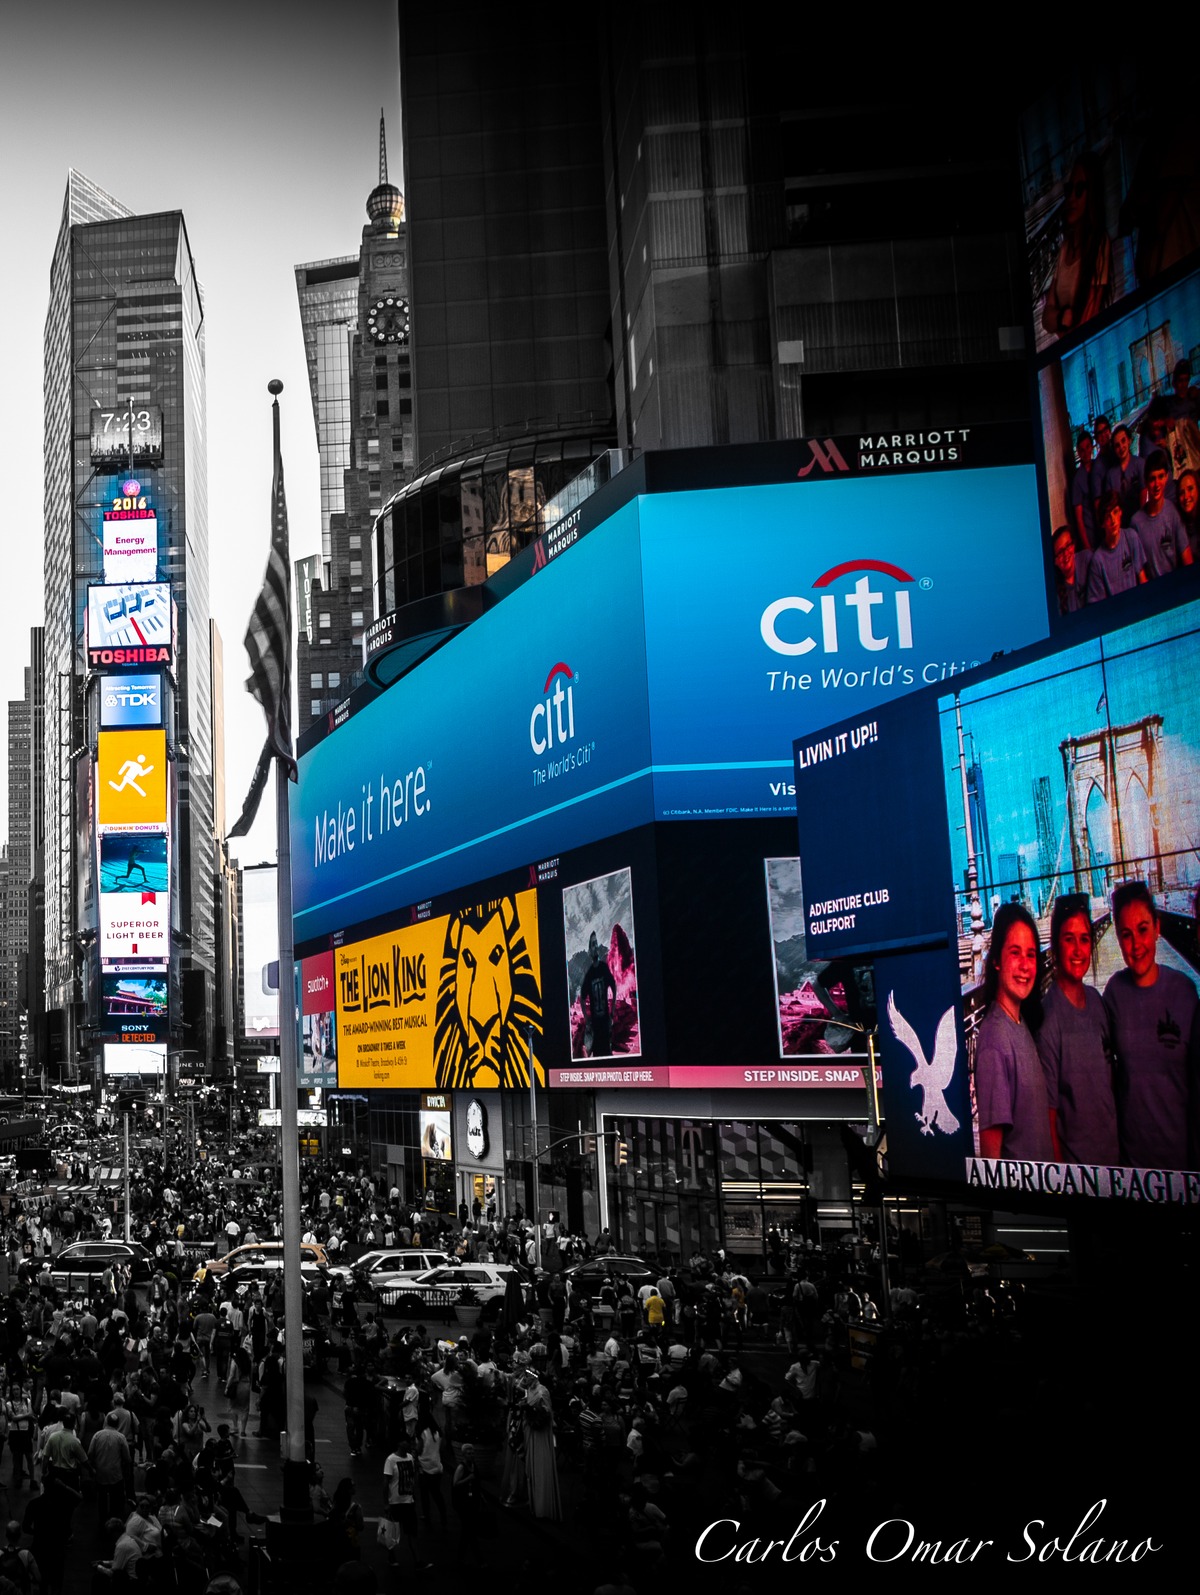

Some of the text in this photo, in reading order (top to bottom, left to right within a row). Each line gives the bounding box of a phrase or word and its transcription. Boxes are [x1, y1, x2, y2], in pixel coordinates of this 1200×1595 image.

[101, 411, 151, 433] 7:23
[859, 429, 970, 449] MARRIOTT
[860, 447, 960, 468] MARQUIS
[112, 497, 147, 511] 2016
[103, 508, 156, 521] TOSHIBA
[547, 509, 582, 544] MARRIOTT
[115, 535, 145, 546] Energy
[548, 527, 578, 559] MARQUIS
[103, 545, 156, 557] Management
[760, 575, 914, 656] citi
[89, 647, 170, 664] TOSHIBA
[766, 670, 813, 692] The
[820, 664, 915, 689] World's
[117, 692, 157, 707] TDK
[334, 697, 351, 715] MARRIOTT
[334, 711, 350, 727] MARQUIS
[530, 677, 575, 756] citi
[798, 721, 878, 770] LIVIN IT UP!!
[532, 744, 591, 787] The World's Citi
[769, 782, 797, 796] Vis
[314, 766, 431, 868] Make it here.
[538, 858, 560, 871] MARRIOTT
[538, 869, 558, 881] MARQUIS
[808, 889, 890, 918] ADVENTURE CLUB
[110, 920, 160, 929] SUPERIOR
[809, 914, 856, 936] GULFPORT
[106, 932, 135, 940] LIGHT
[340, 944, 427, 1014] THE LION KING
[343, 1014, 428, 1036] THE AWARD-WINNING BEST MUSICAL
[122, 1033, 156, 1042] DETECTED
[357, 1041, 406, 1053] ON BROADWAY TIMES WEEK
[560, 1071, 654, 1082] STEP INSIDE. SNAP YOUR PHOTO. GET UP HERE.
[744, 1070, 775, 1082] STEP
[777, 1070, 823, 1082] INSIDE.
[825, 1070, 859, 1082] SNAP
[969, 1158, 1200, 1204] AMERICAN EAGLE
